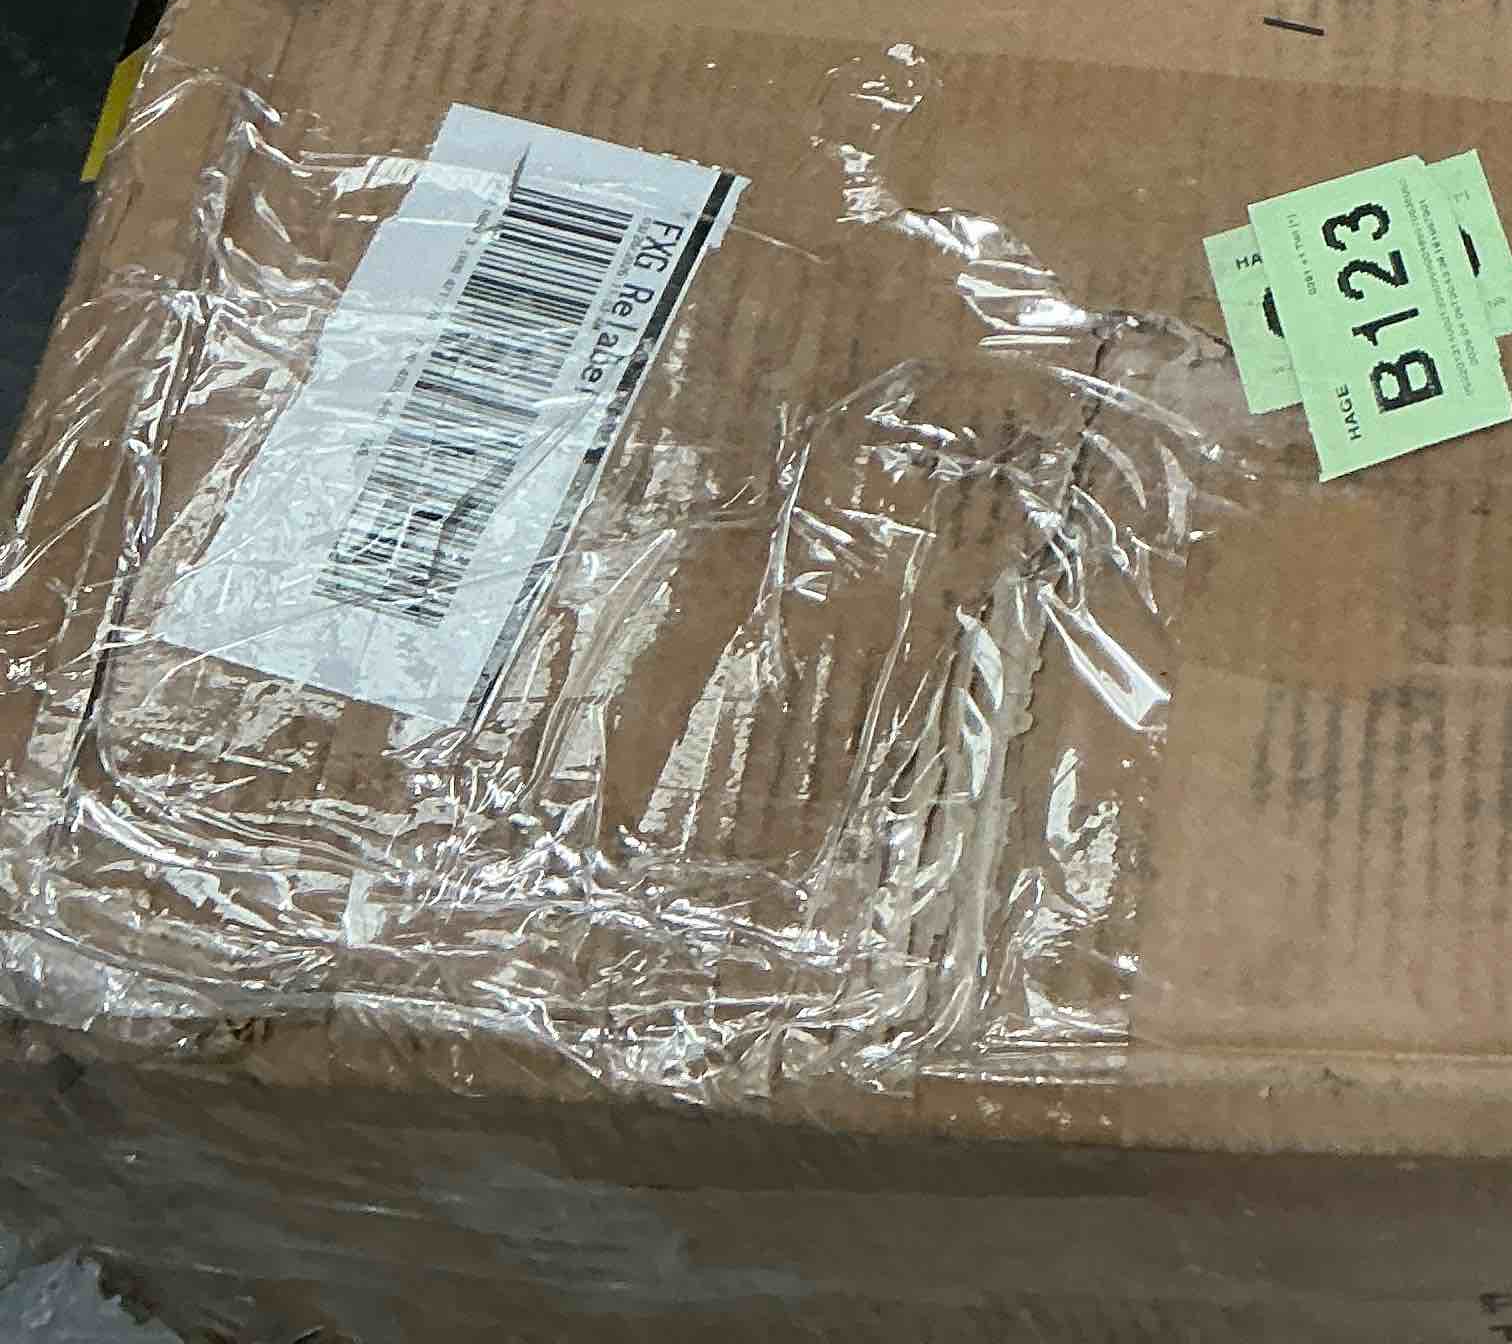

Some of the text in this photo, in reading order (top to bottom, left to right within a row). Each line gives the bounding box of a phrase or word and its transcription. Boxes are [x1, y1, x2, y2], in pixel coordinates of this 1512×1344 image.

[634, 220, 684, 273] FXG
[1321, 203, 1443, 414] B123
[1335, 383, 1362, 440] HAGE
